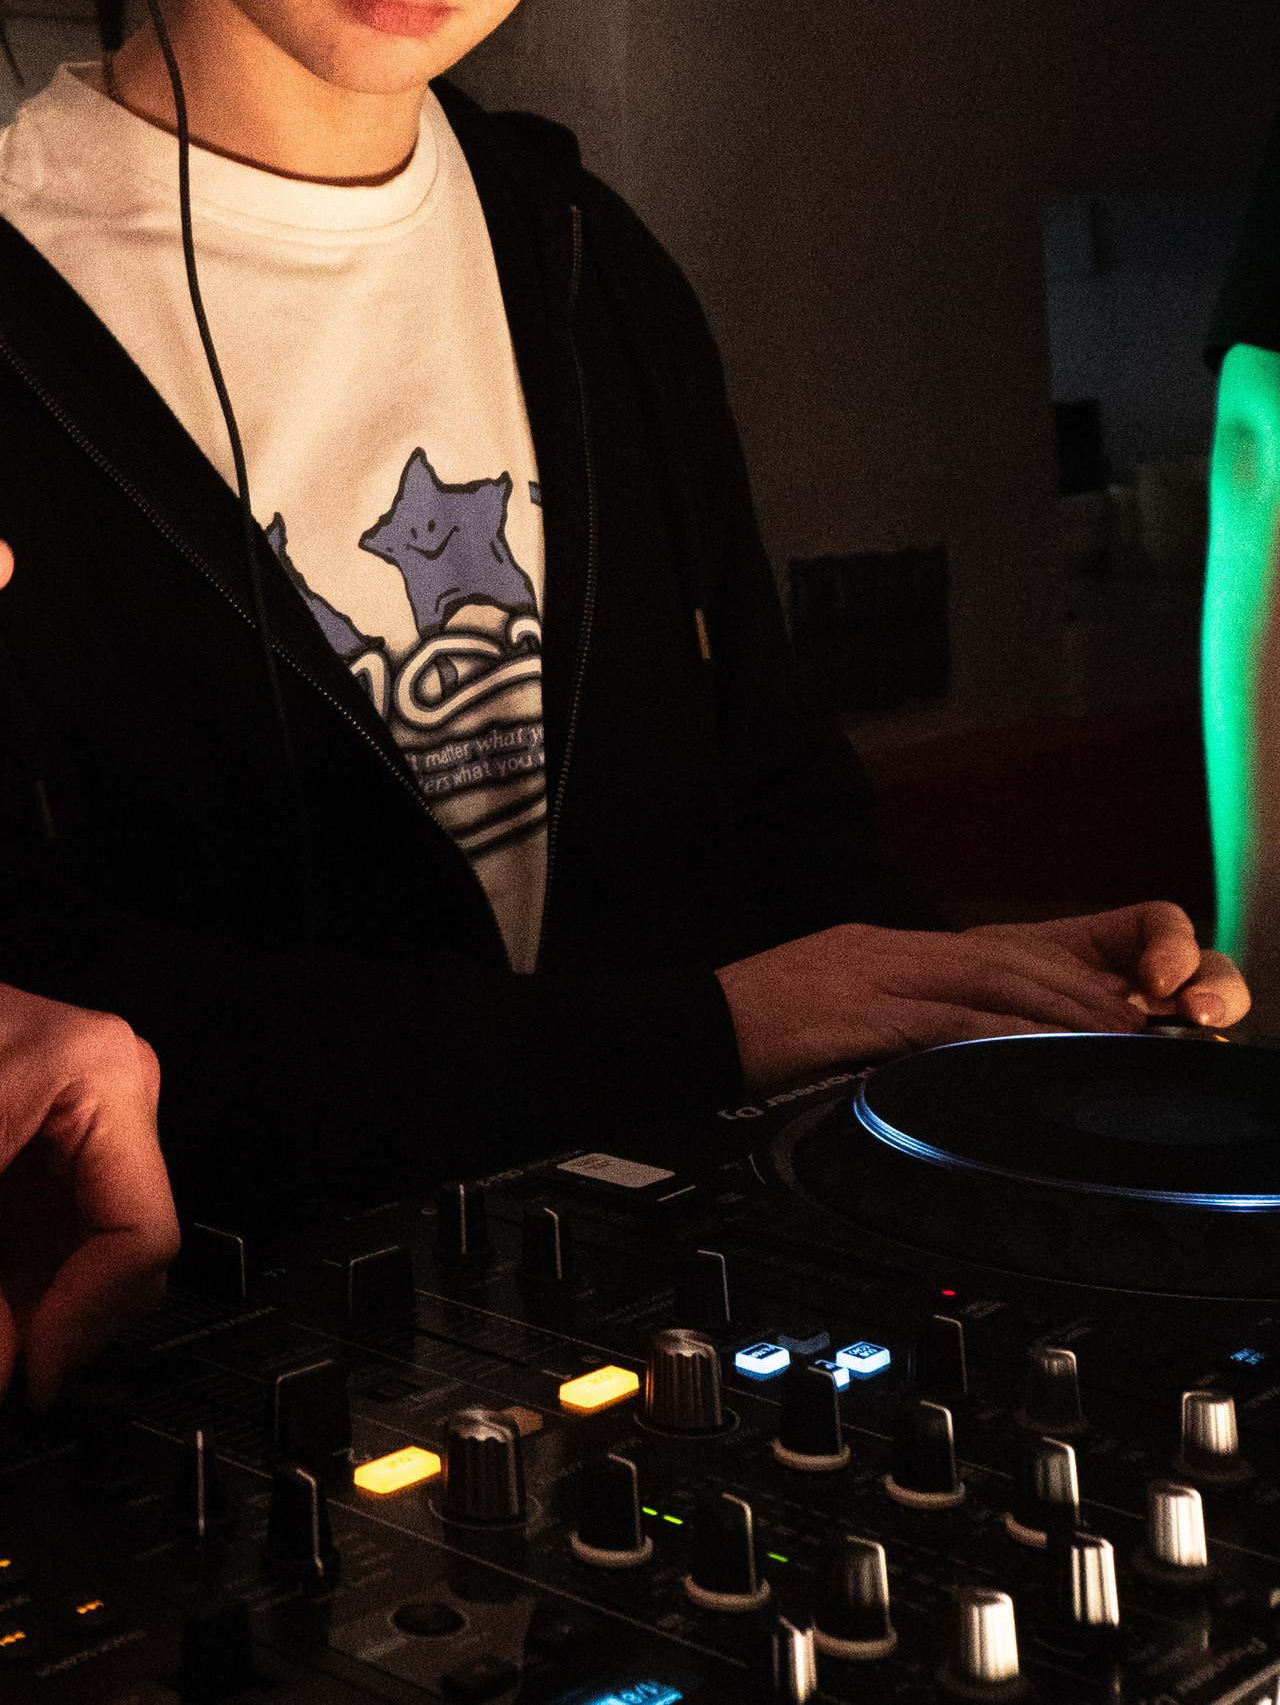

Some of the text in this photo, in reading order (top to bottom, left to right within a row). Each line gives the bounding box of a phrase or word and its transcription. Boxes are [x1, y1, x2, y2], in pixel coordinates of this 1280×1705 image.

[425, 741, 470, 769] matter
[475, 727, 523, 752] what
[452, 761, 494, 785] what
[496, 753, 534, 777] you
